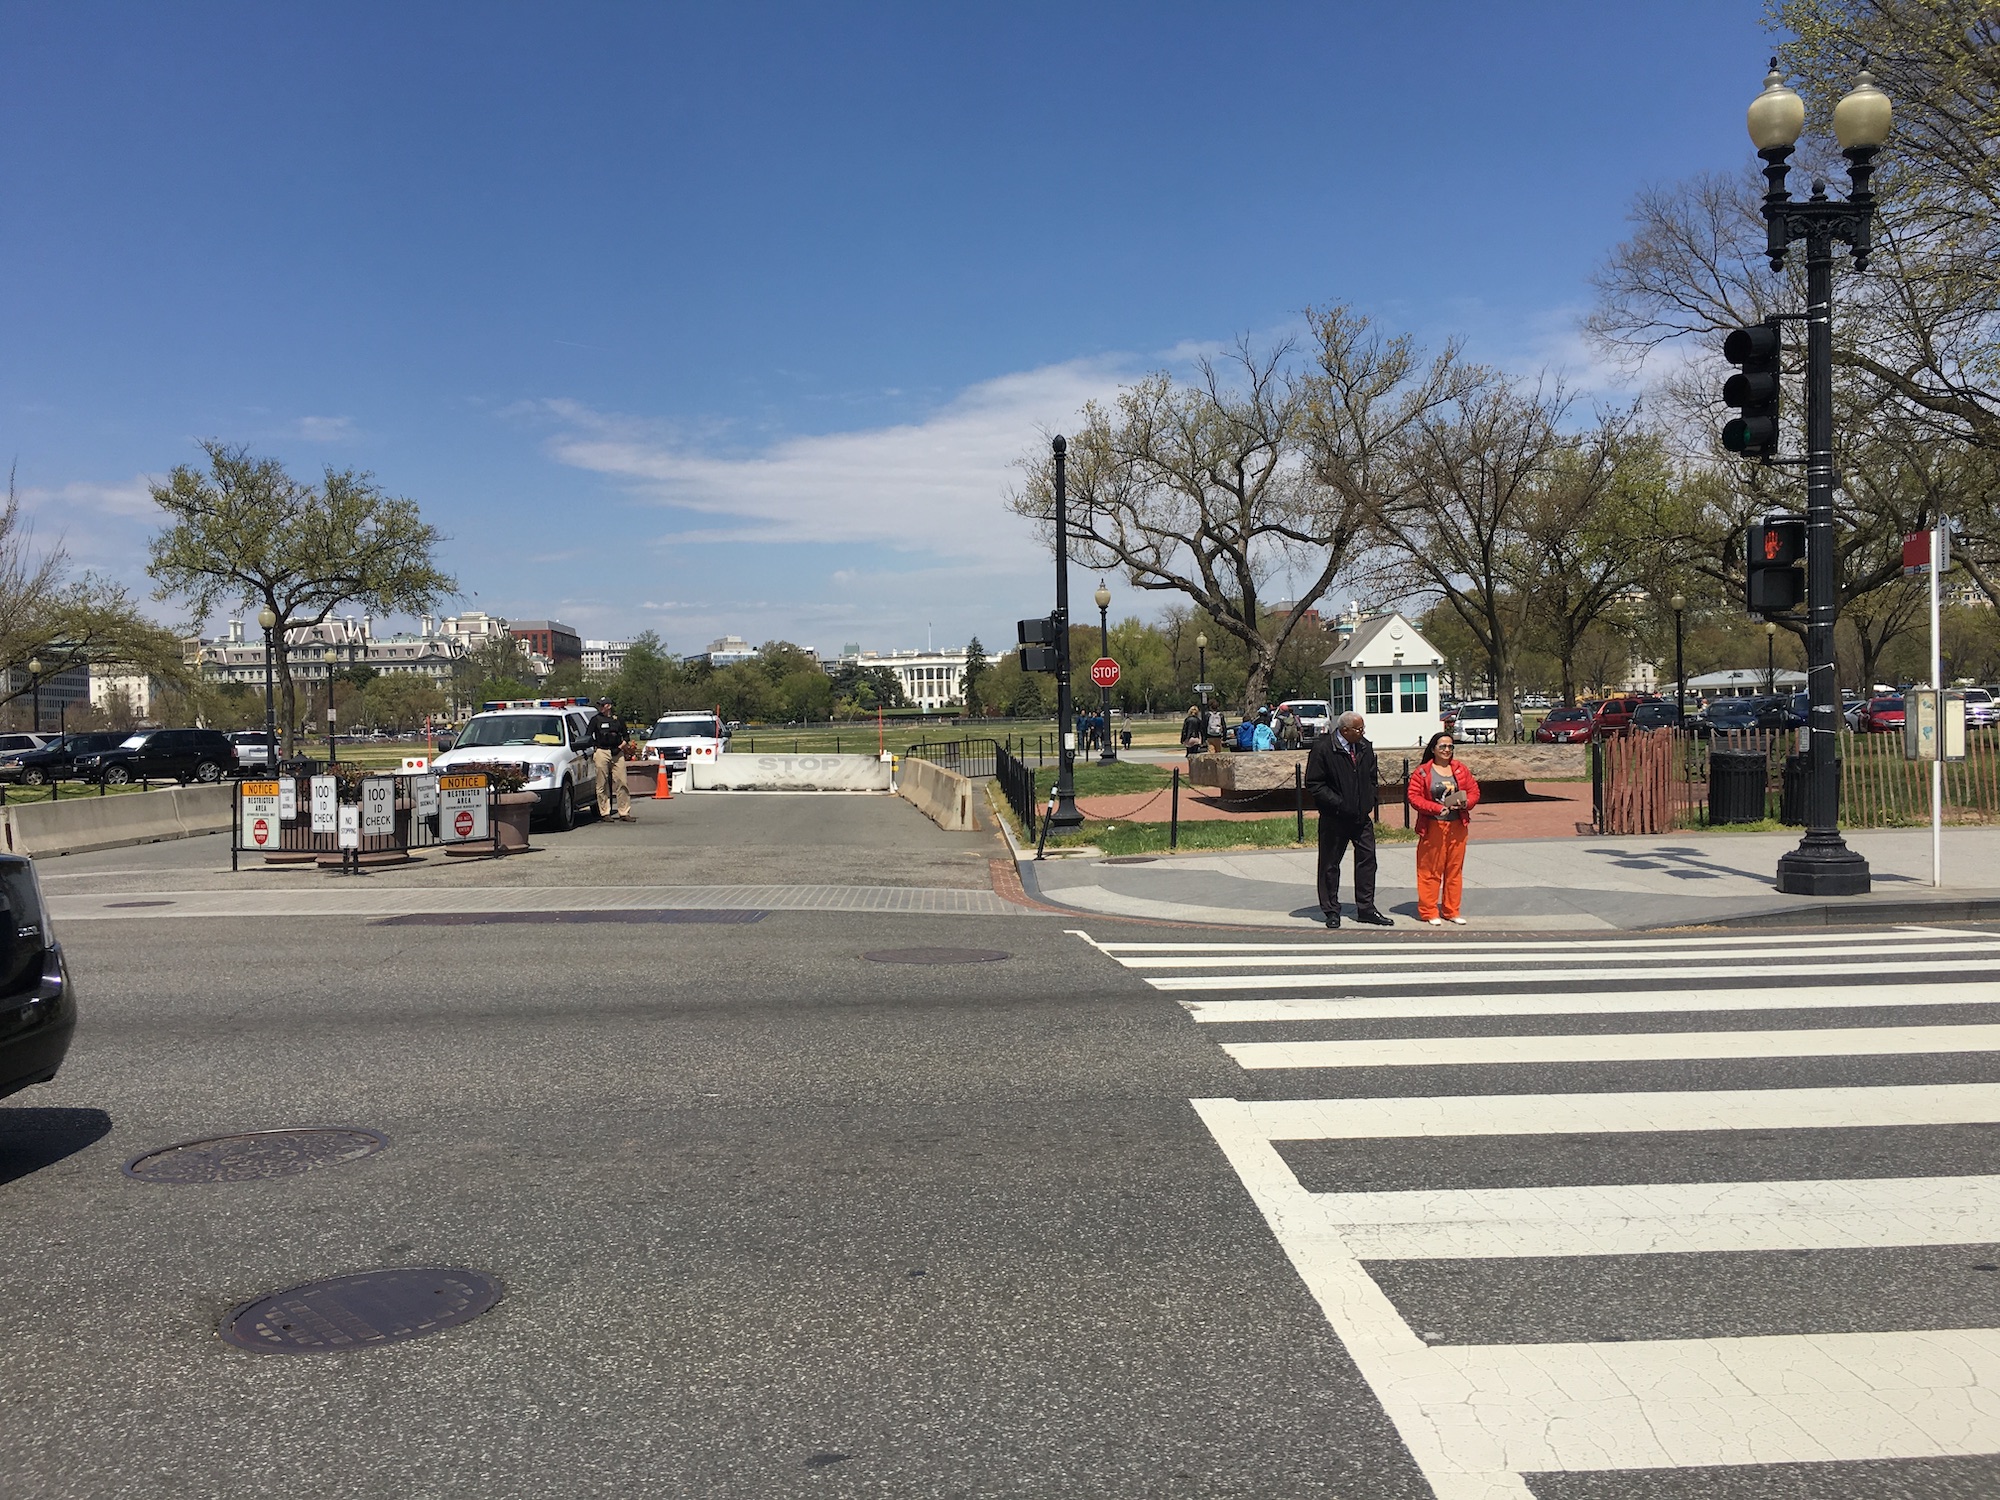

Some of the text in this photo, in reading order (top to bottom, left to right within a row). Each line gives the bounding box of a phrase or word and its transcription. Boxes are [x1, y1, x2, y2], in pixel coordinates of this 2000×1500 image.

[1093, 667, 1118, 679] STOP
[758, 757, 842, 771] STOP
[448, 777, 479, 788] NOTICE
[248, 784, 274, 795] NOTICE
[315, 785, 334, 798] 100%
[368, 788, 391, 801] 100%
[447, 789, 480, 798] RESTRICTED
[320, 801, 328, 811] ID
[374, 804, 383, 814] ID
[314, 813, 334, 823] CHECK
[345, 816, 353, 825] NO
[366, 815, 391, 827] CHECK
[340, 827, 357, 835] STOPPING
